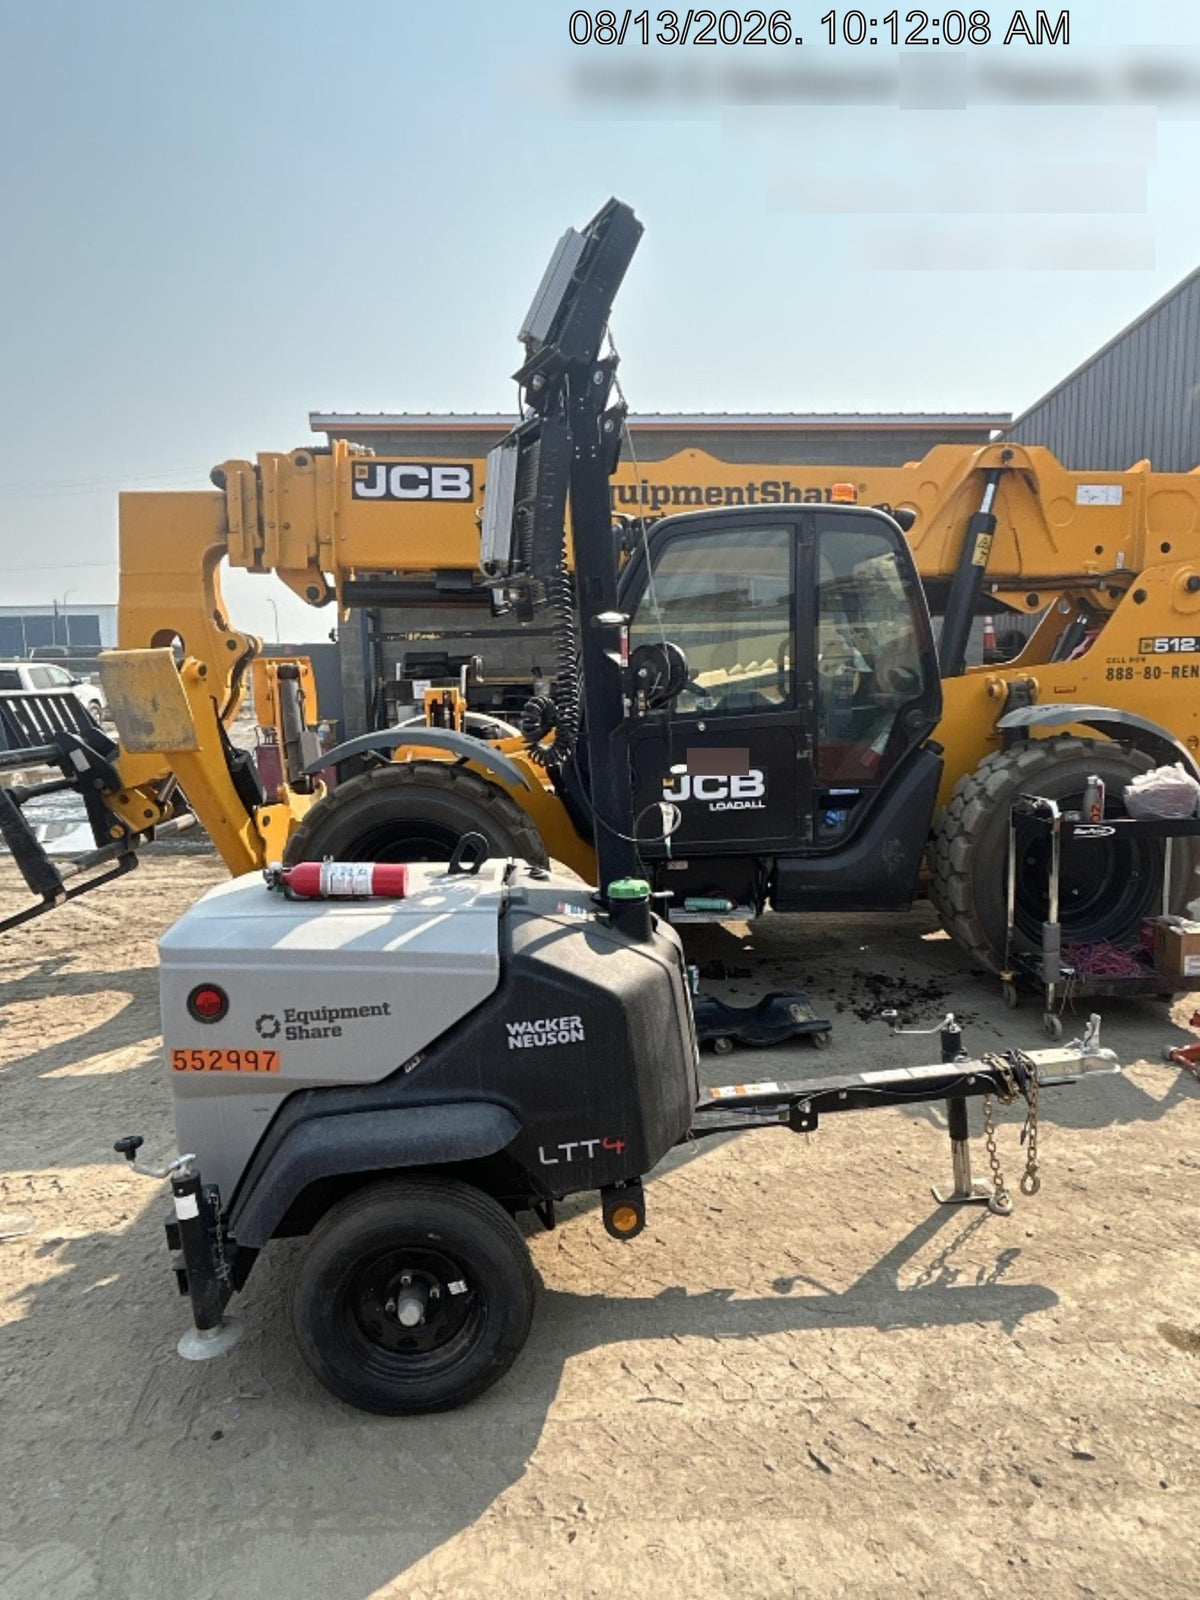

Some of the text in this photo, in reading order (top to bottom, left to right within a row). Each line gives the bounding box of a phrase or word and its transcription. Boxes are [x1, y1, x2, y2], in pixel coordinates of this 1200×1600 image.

[354, 465, 472, 499] JCB
[662, 768, 766, 801] JCB
[709, 800, 766, 812] LOADALL
[284, 1001, 392, 1025] Equipment
[285, 1024, 342, 1041] Share
[506, 1014, 584, 1036] WACKER
[507, 1028, 586, 1050] NEUSON
[173, 1050, 277, 1071] 552997
